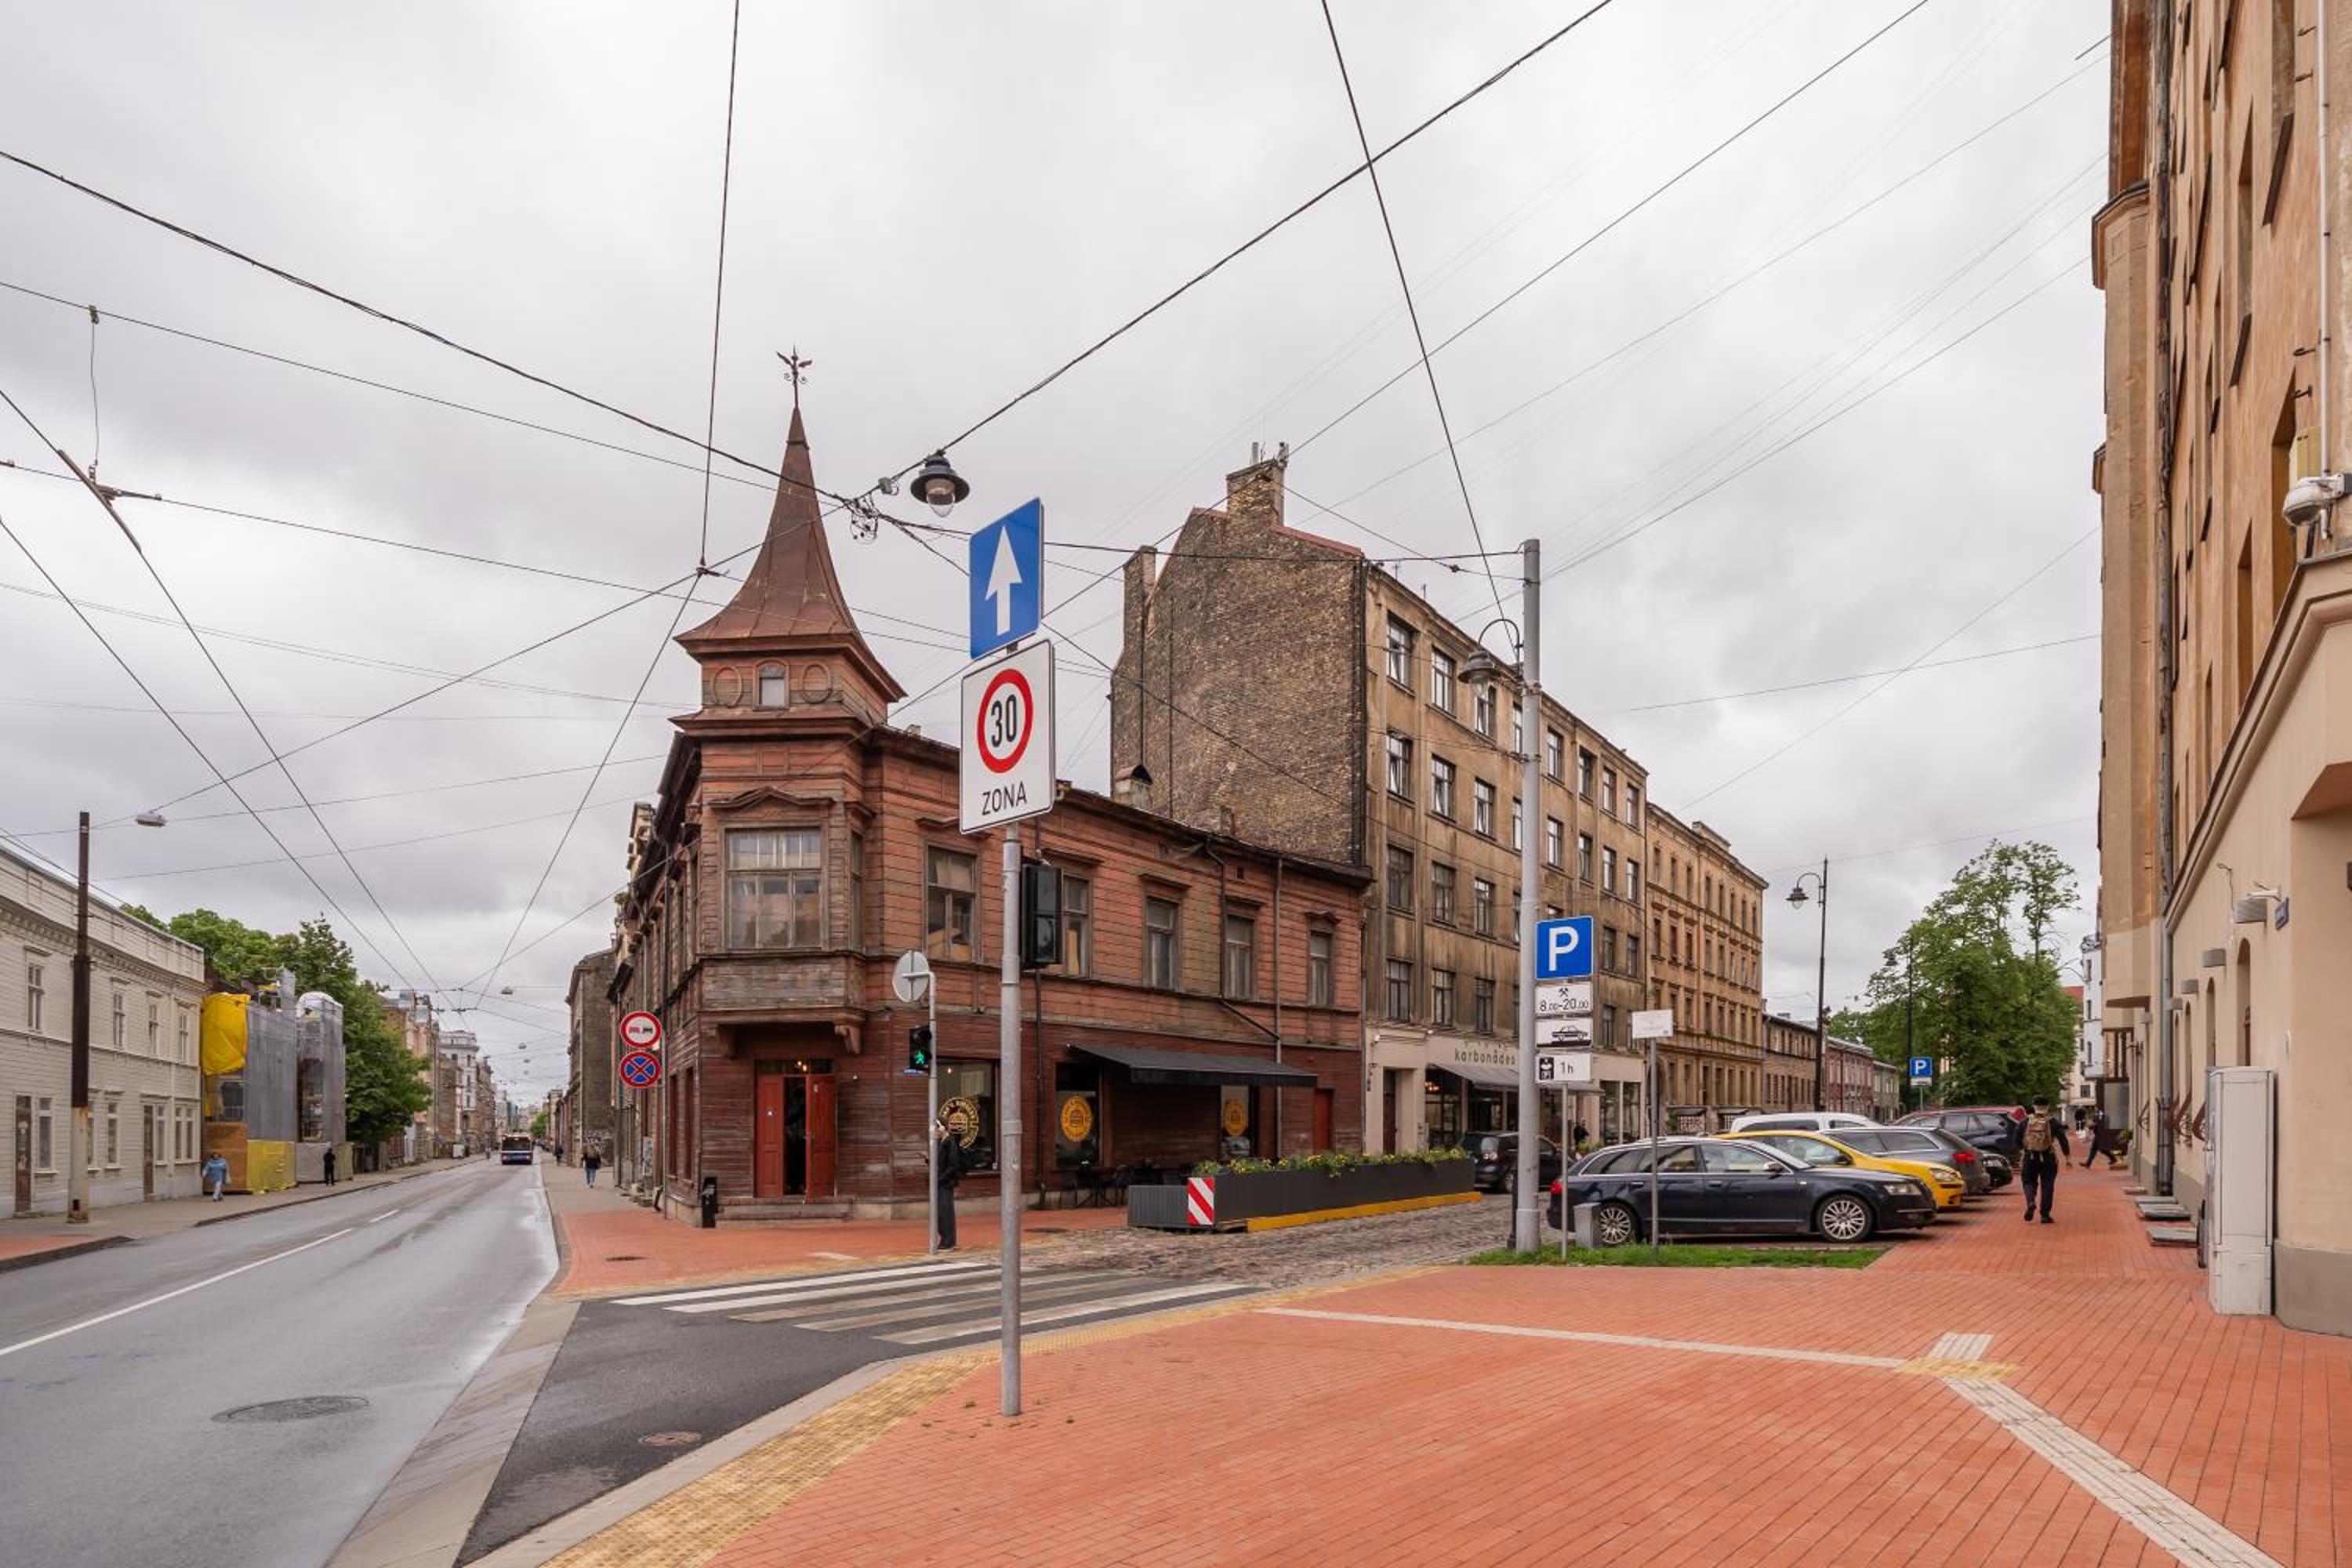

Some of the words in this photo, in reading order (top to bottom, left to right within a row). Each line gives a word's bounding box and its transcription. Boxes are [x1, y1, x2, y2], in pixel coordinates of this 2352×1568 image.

[991, 695, 1017, 747] 30
[982, 781, 1028, 816] ZONA
[1548, 926, 1579, 971] P
[1915, 1059, 1926, 1075] P
